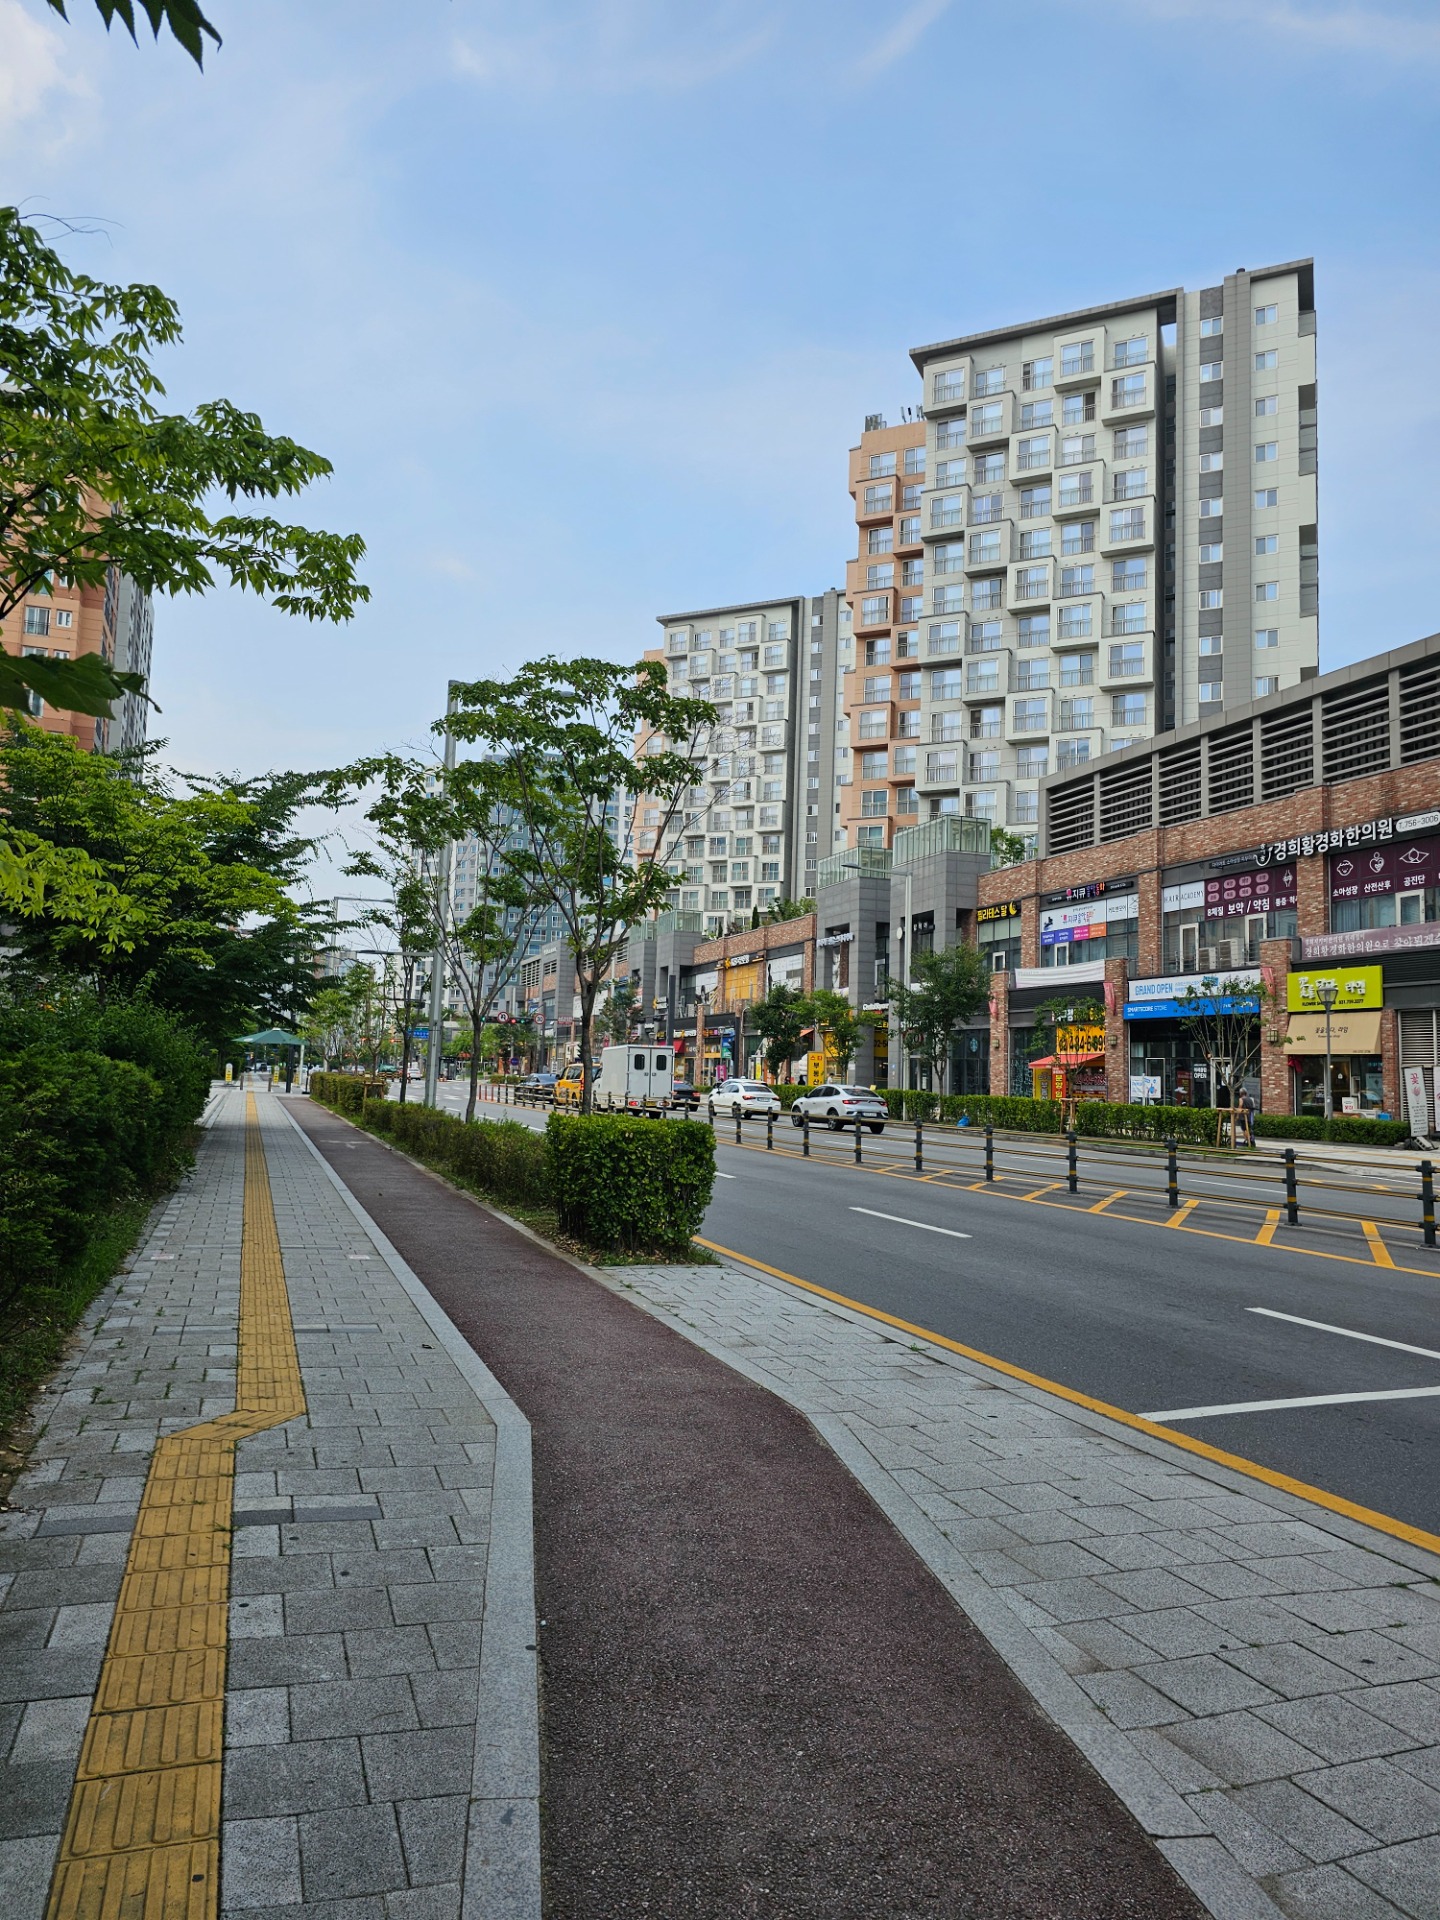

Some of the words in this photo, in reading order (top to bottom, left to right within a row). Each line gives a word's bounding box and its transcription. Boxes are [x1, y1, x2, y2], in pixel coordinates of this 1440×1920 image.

[1274, 818, 1393, 861] 경희황경화한의원
[1363, 880, 1392, 893] 산전산후
[1403, 874, 1426, 887] 공진단
[1181, 890, 1204, 900] ACADEMY
[977, 907, 1000, 922] 필라테스
[1000, 905, 1008, 917] 달
[1207, 906, 1224, 917] 8체질
[1228, 901, 1244, 915] 보약
[1252, 898, 1270, 912] 약침
[1135, 985, 1156, 996] GRAND
[1157, 983, 1173, 994] OPEN
[1345, 980, 1366, 996] 라임
[1410, 1072, 1420, 1085] 꽃
